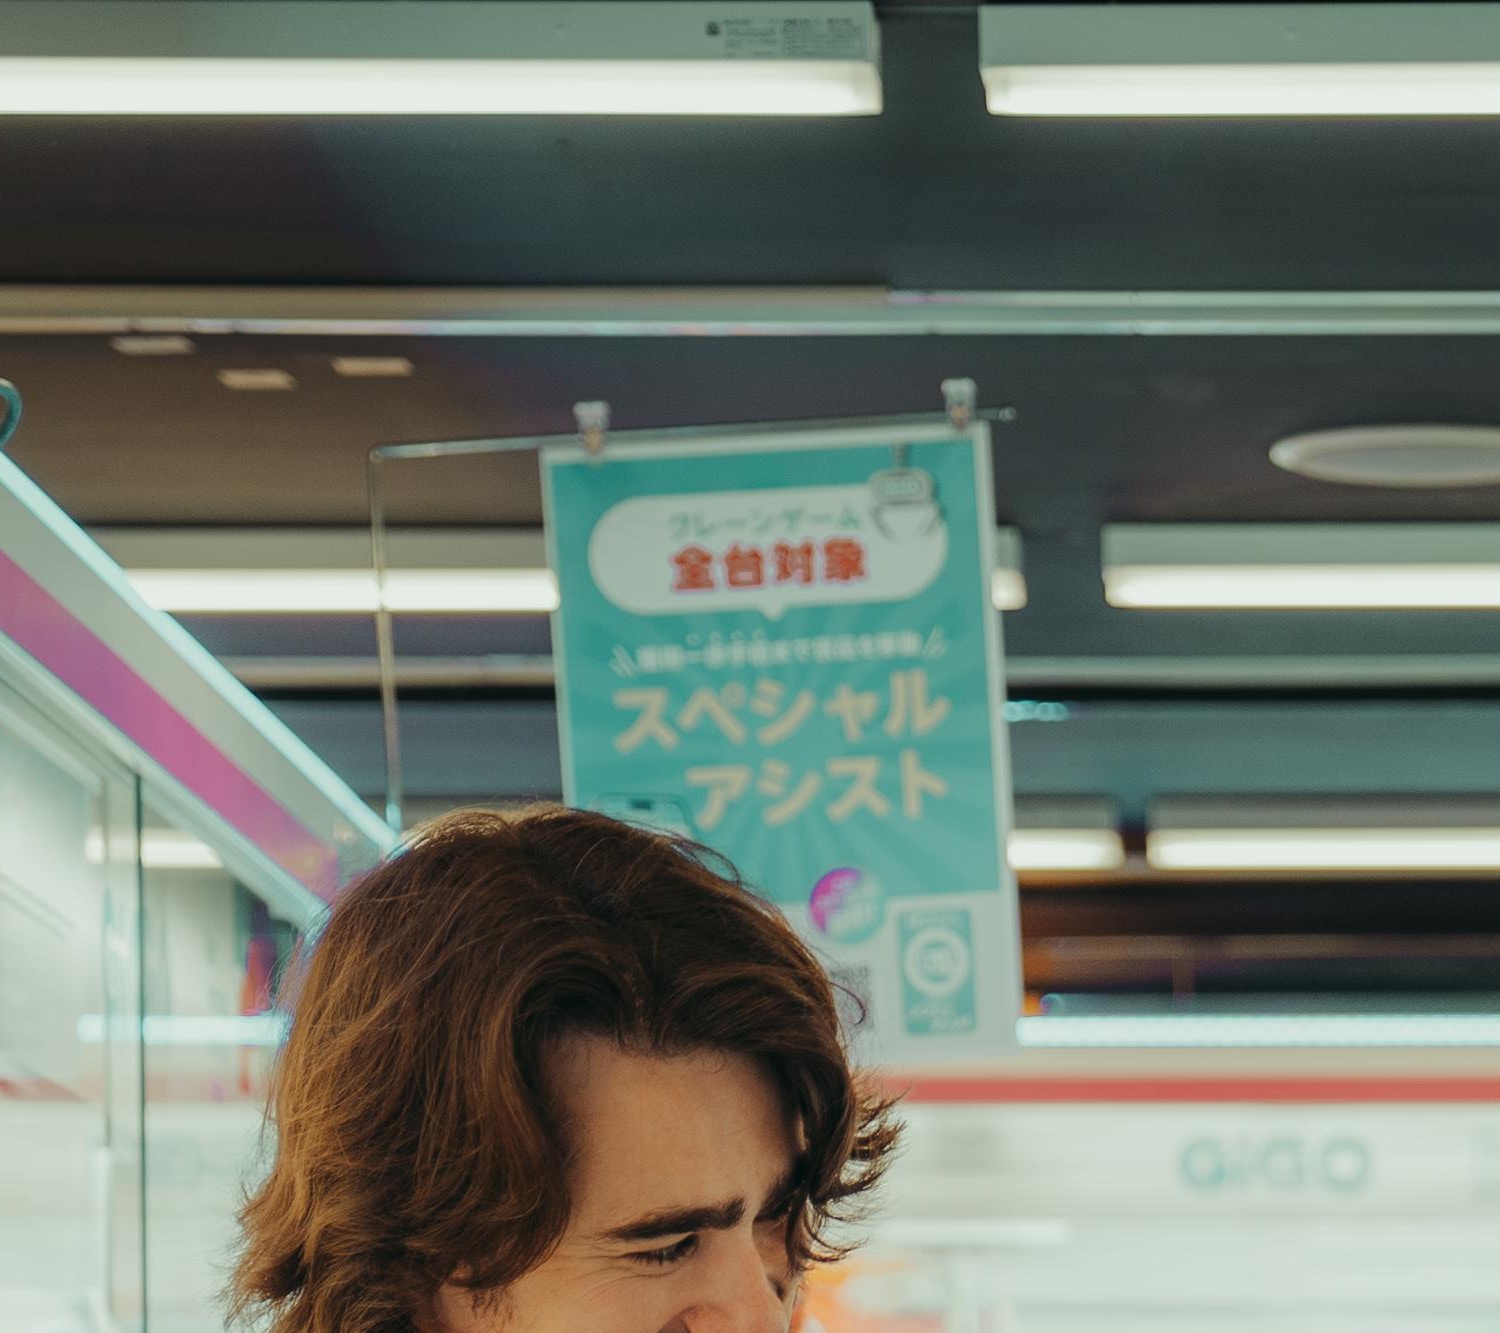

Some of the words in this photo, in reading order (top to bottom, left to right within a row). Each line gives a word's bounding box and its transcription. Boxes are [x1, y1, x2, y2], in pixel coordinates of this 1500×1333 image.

[670, 535, 870, 593] 全台対象
[611, 669, 950, 754] スペシャル
[686, 755, 950, 827] アシスト
